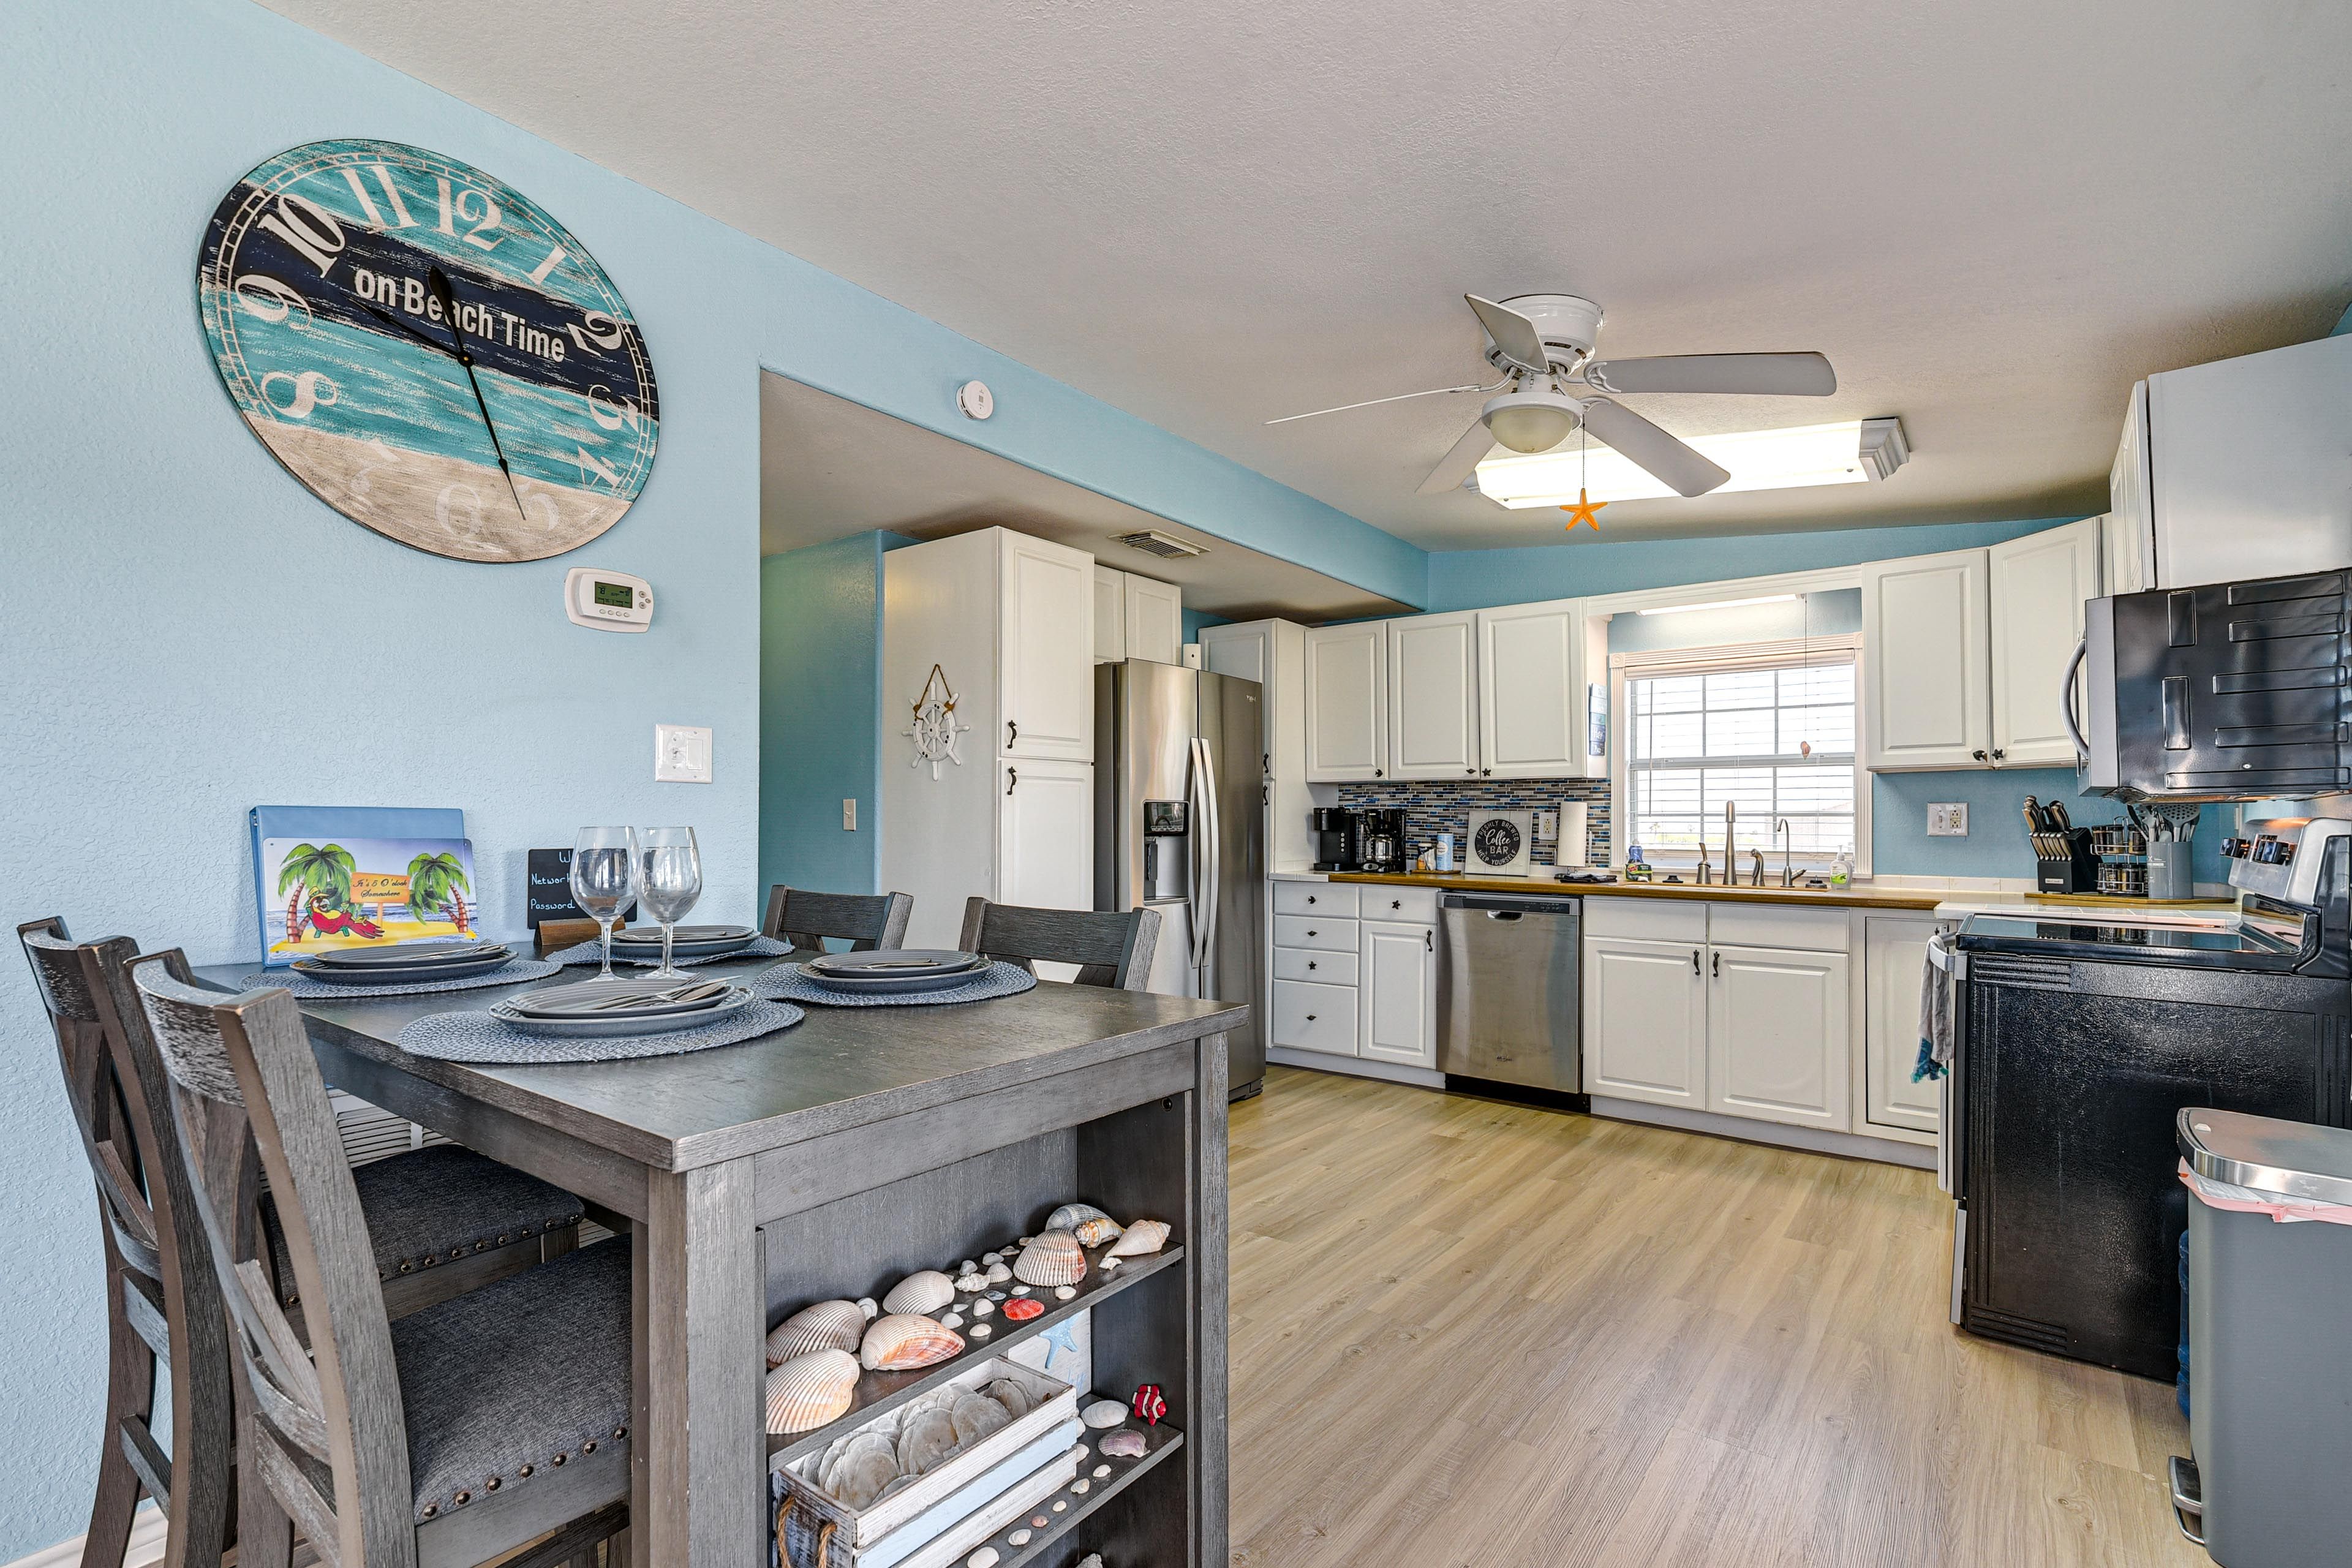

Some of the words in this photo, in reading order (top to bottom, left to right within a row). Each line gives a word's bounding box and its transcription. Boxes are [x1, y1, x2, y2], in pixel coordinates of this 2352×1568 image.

[336, 165, 421, 235] 11
[430, 176, 505, 251] 12
[257, 193, 346, 279] 10
[522, 246, 567, 285] 1
[235, 274, 313, 331] 9
[355, 268, 397, 307] on
[404, 276, 493, 341] Beach
[501, 312, 565, 363] Time
[566, 310, 623, 357] 2
[260, 371, 339, 418] 8
[588, 383, 639, 432] 3
[577, 445, 626, 492] 4
[435, 483, 483, 537] 6
[1476, 820, 1499, 839] FRESHLY
[1501, 821, 1520, 841] BREWED
[1483, 829, 1511, 846] Coffee
[1490, 846, 1509, 854] BAR
[1477, 849, 1490, 862] HELP
[1491, 849, 1517, 865] YOURSELF
[353, 878, 369, 888] It's
[361, 889, 401, 899] Somewhere
[530, 899, 576, 910] Password
